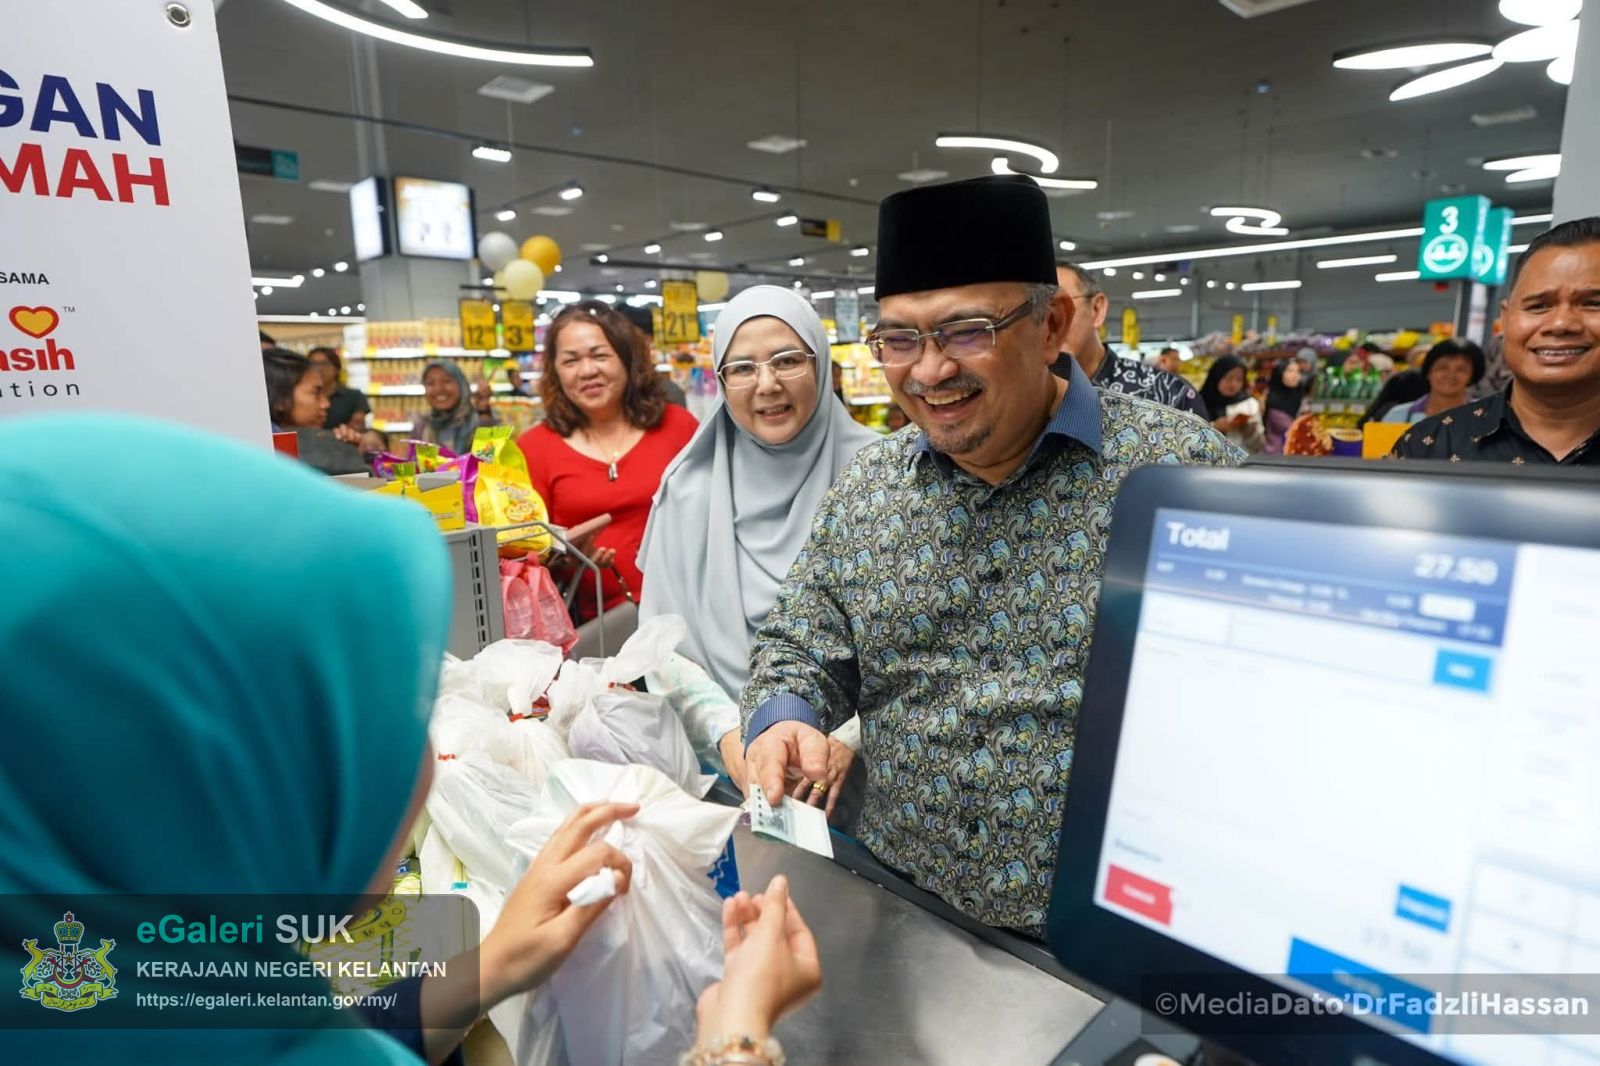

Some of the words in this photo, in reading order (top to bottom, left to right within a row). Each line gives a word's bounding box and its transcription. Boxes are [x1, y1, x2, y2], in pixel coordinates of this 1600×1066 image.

[0, 143, 170, 206] MAH
[1439, 206, 1459, 234] 3
[0, 272, 50, 285] SAMA
[0, 381, 80, 397] tion
[1166, 521, 1230, 551] Total
